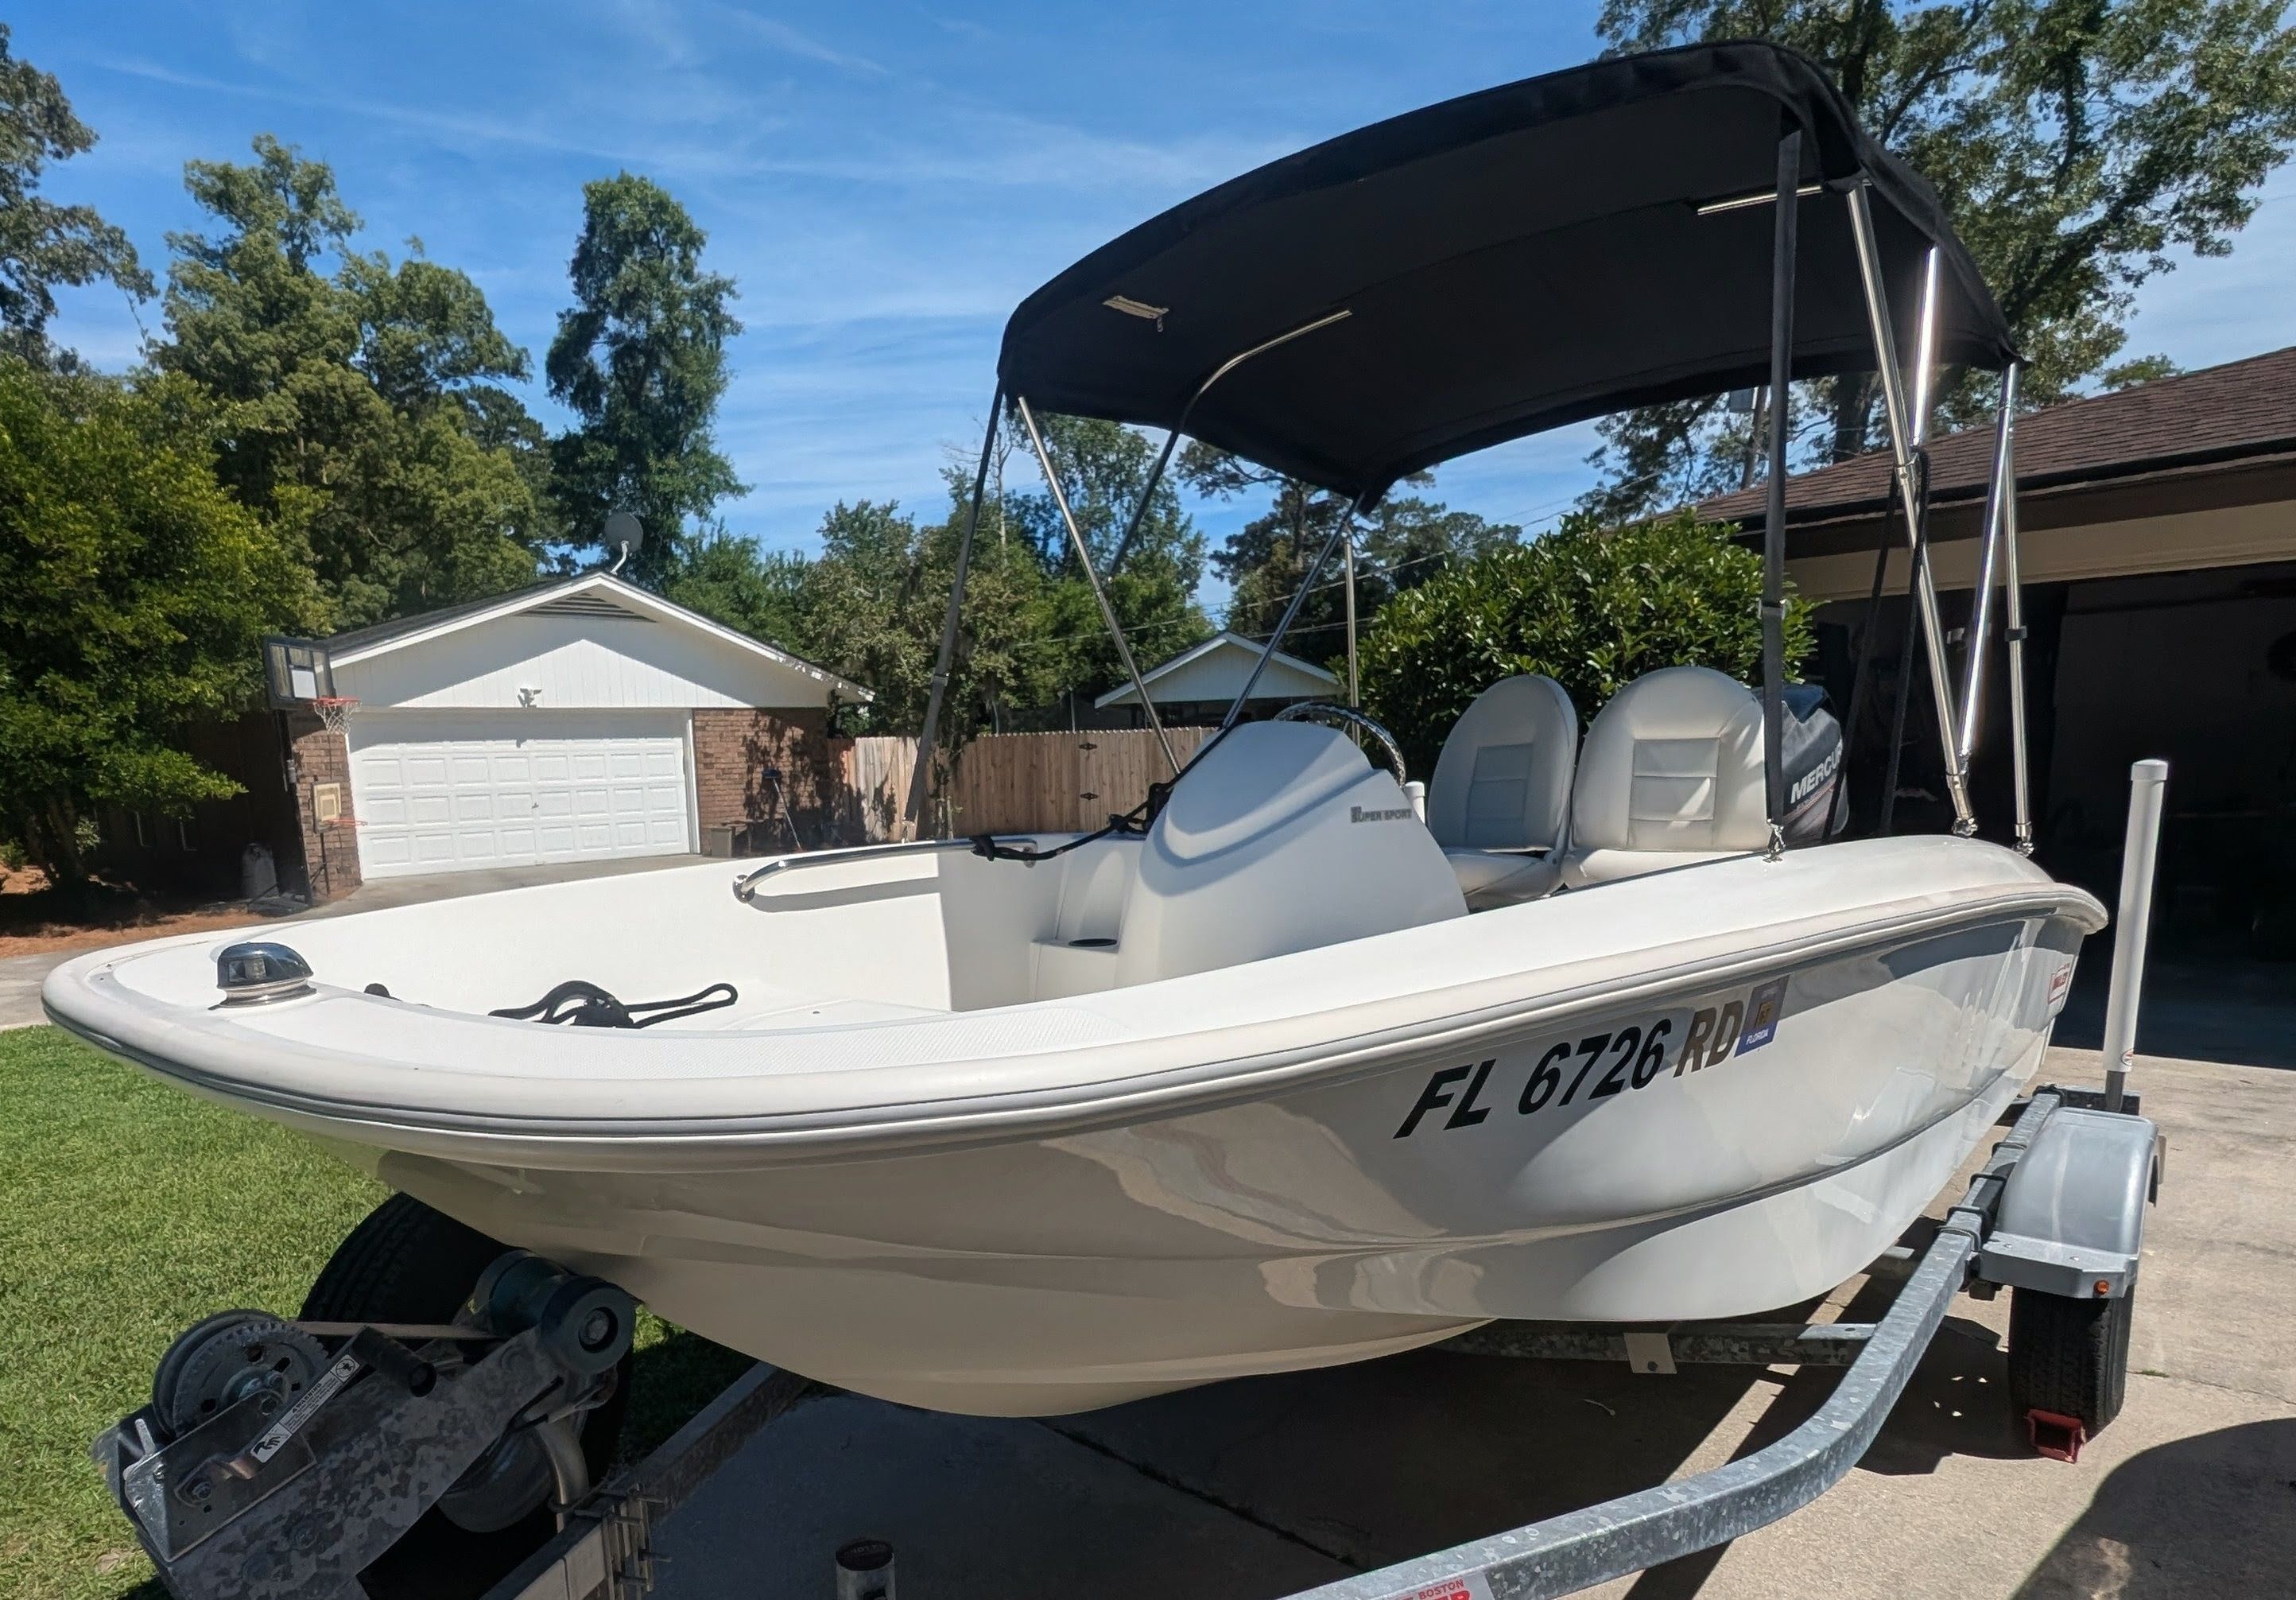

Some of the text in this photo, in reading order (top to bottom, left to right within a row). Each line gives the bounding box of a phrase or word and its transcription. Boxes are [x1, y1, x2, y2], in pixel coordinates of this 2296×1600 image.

[1384, 809, 1413, 820] SPORT
[1393, 1000, 1744, 1140] FL 6726 RD
[296, 1383, 322, 1408] WARNING
[1418, 1579, 1464, 1600] BOSTON
